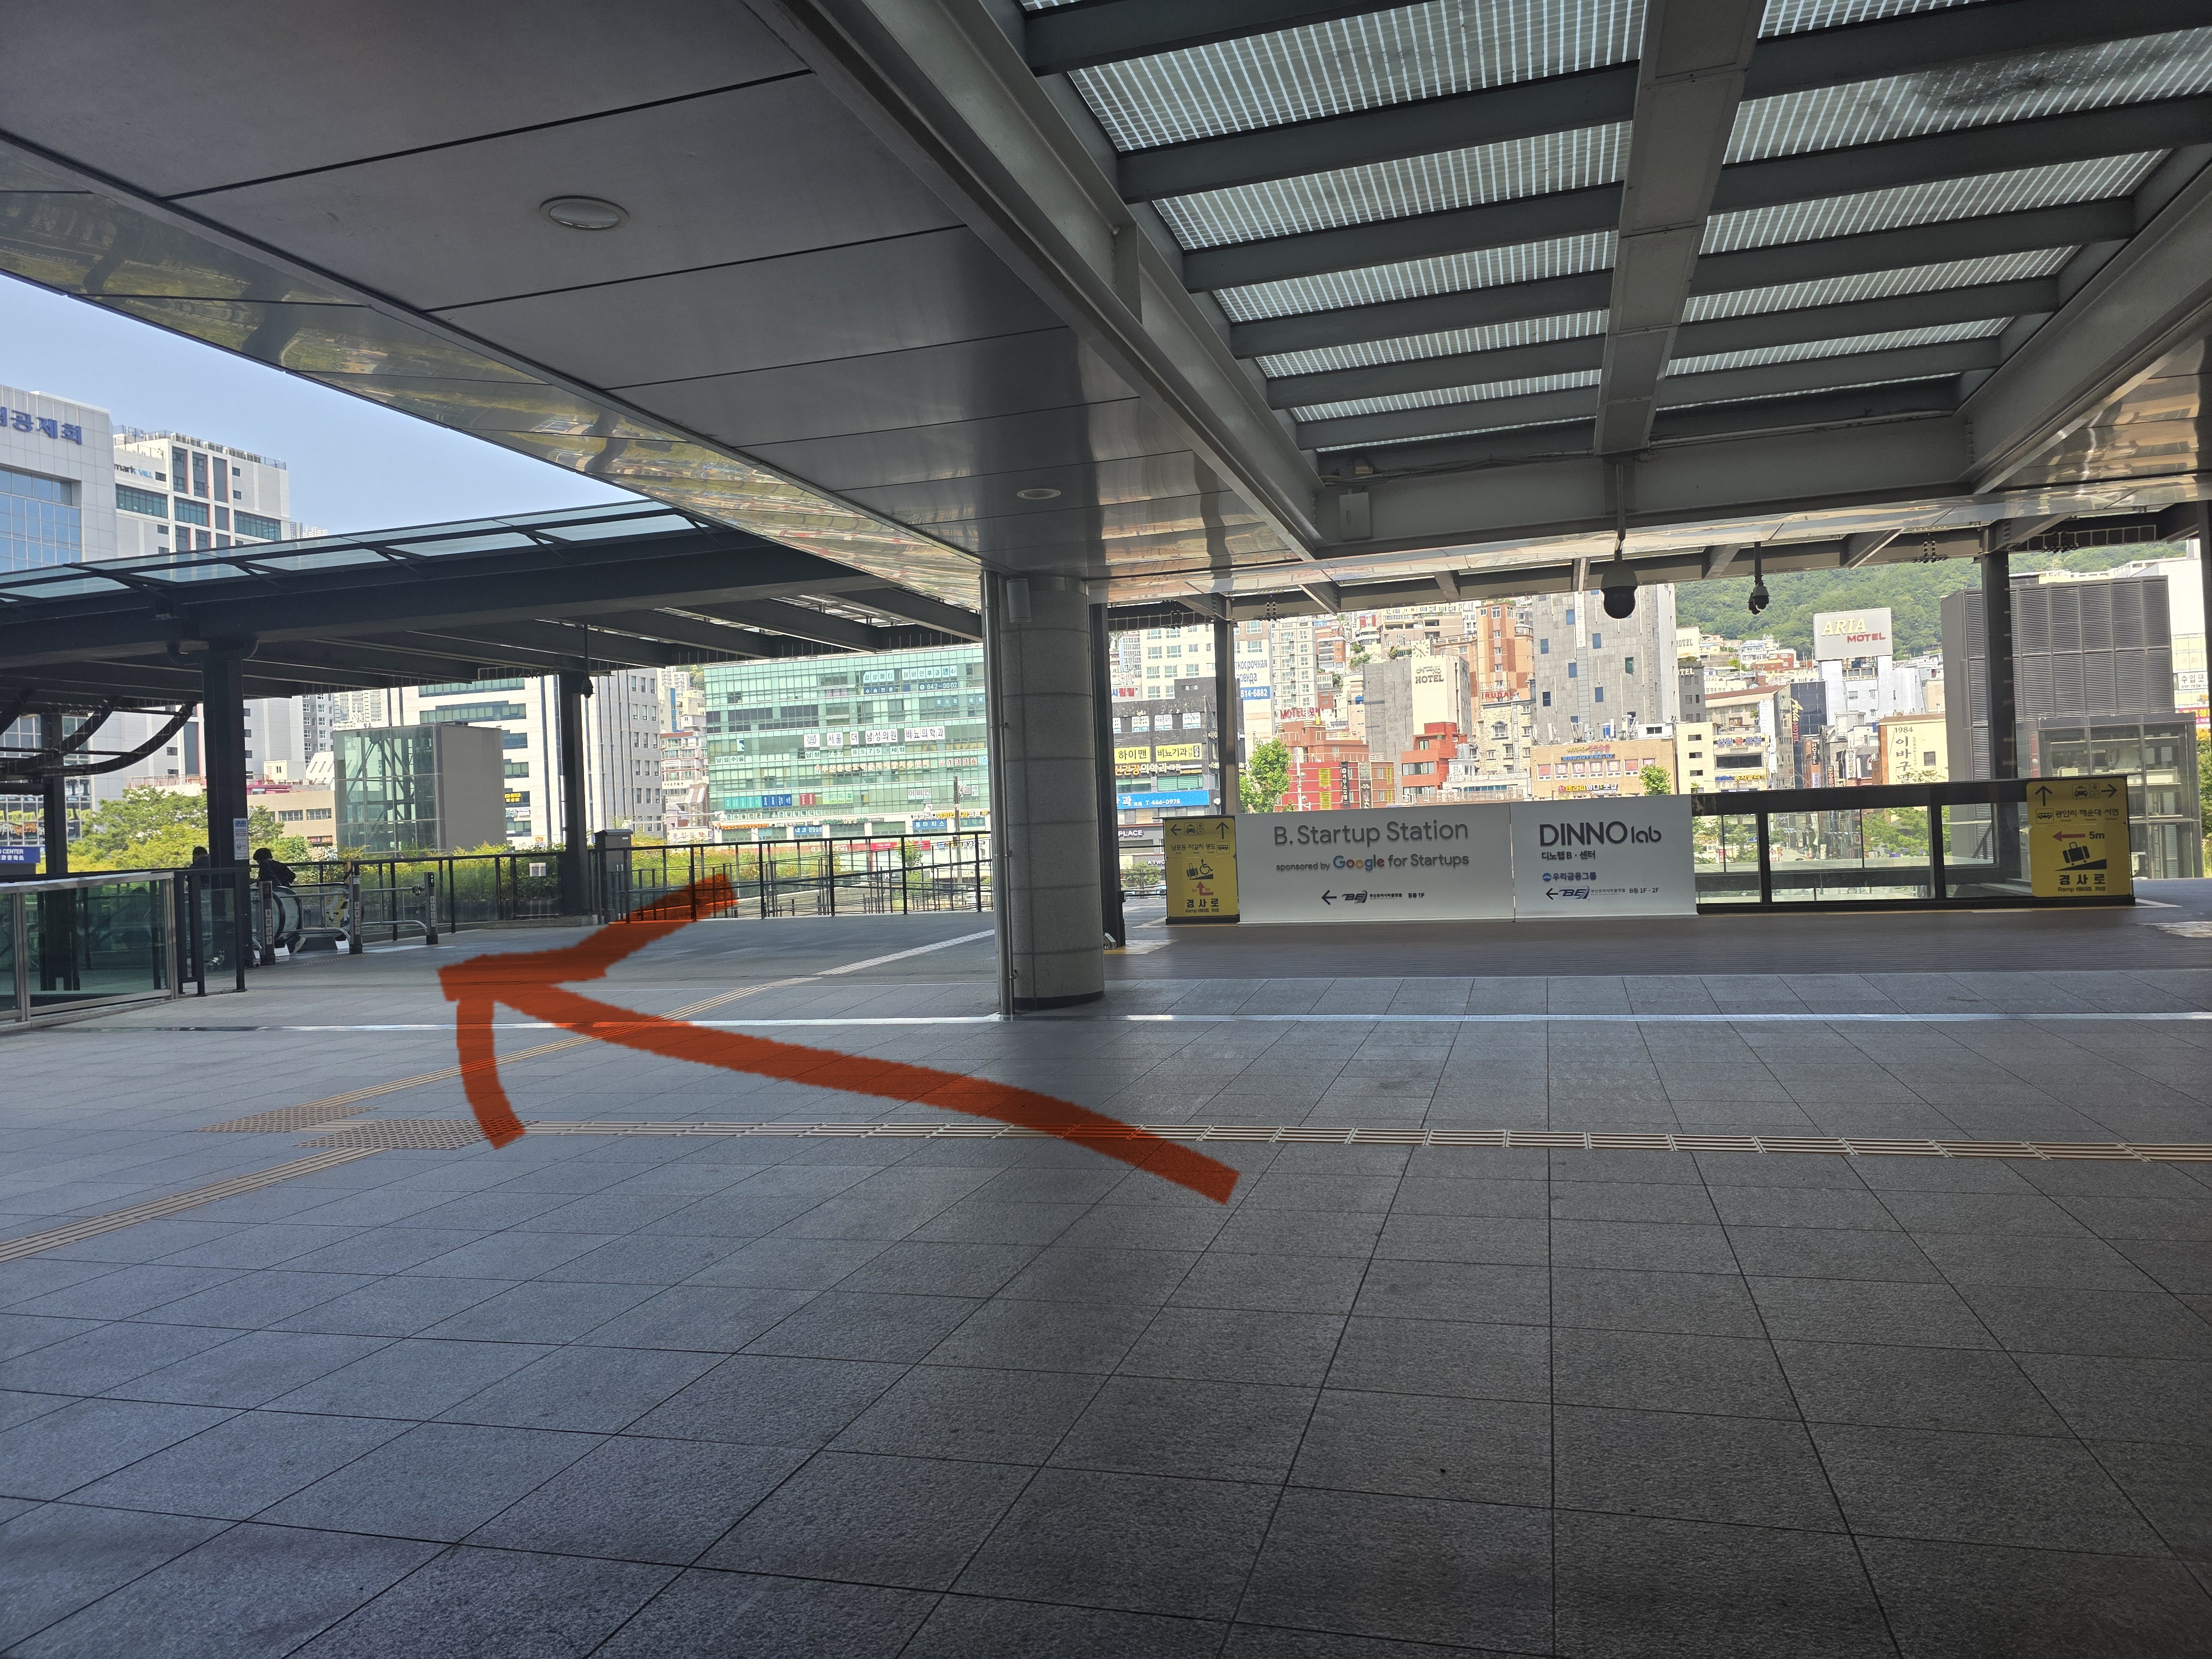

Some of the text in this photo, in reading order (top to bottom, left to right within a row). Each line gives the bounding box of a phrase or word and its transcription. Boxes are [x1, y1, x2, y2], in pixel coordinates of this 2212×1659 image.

[1820, 617, 1866, 637] ARIA
[1847, 632, 1886, 644] MOTEL
[1415, 674, 1444, 684] HOTEL
[828, 728, 945, 744] 서울 더 남성의원 비뇨의학과
[1118, 749, 1147, 760] 하이맨
[1157, 747, 1188, 758] 비뇨기과
[947, 758, 977, 766] 1336
[1274, 820, 1469, 848] B. Startup Station
[1540, 821, 1662, 847] DINNO lab
[2089, 831, 2105, 839] 5m
[1541, 851, 1565, 860] 디노랩
[1579, 850, 1595, 859] 센터
[1276, 853, 1469, 873] sponsored by Google for Startups
[1552, 872, 1597, 882] 우리금융그룹
[2059, 874, 2105, 885] 경사로
[1186, 898, 1219, 907] 경사로
